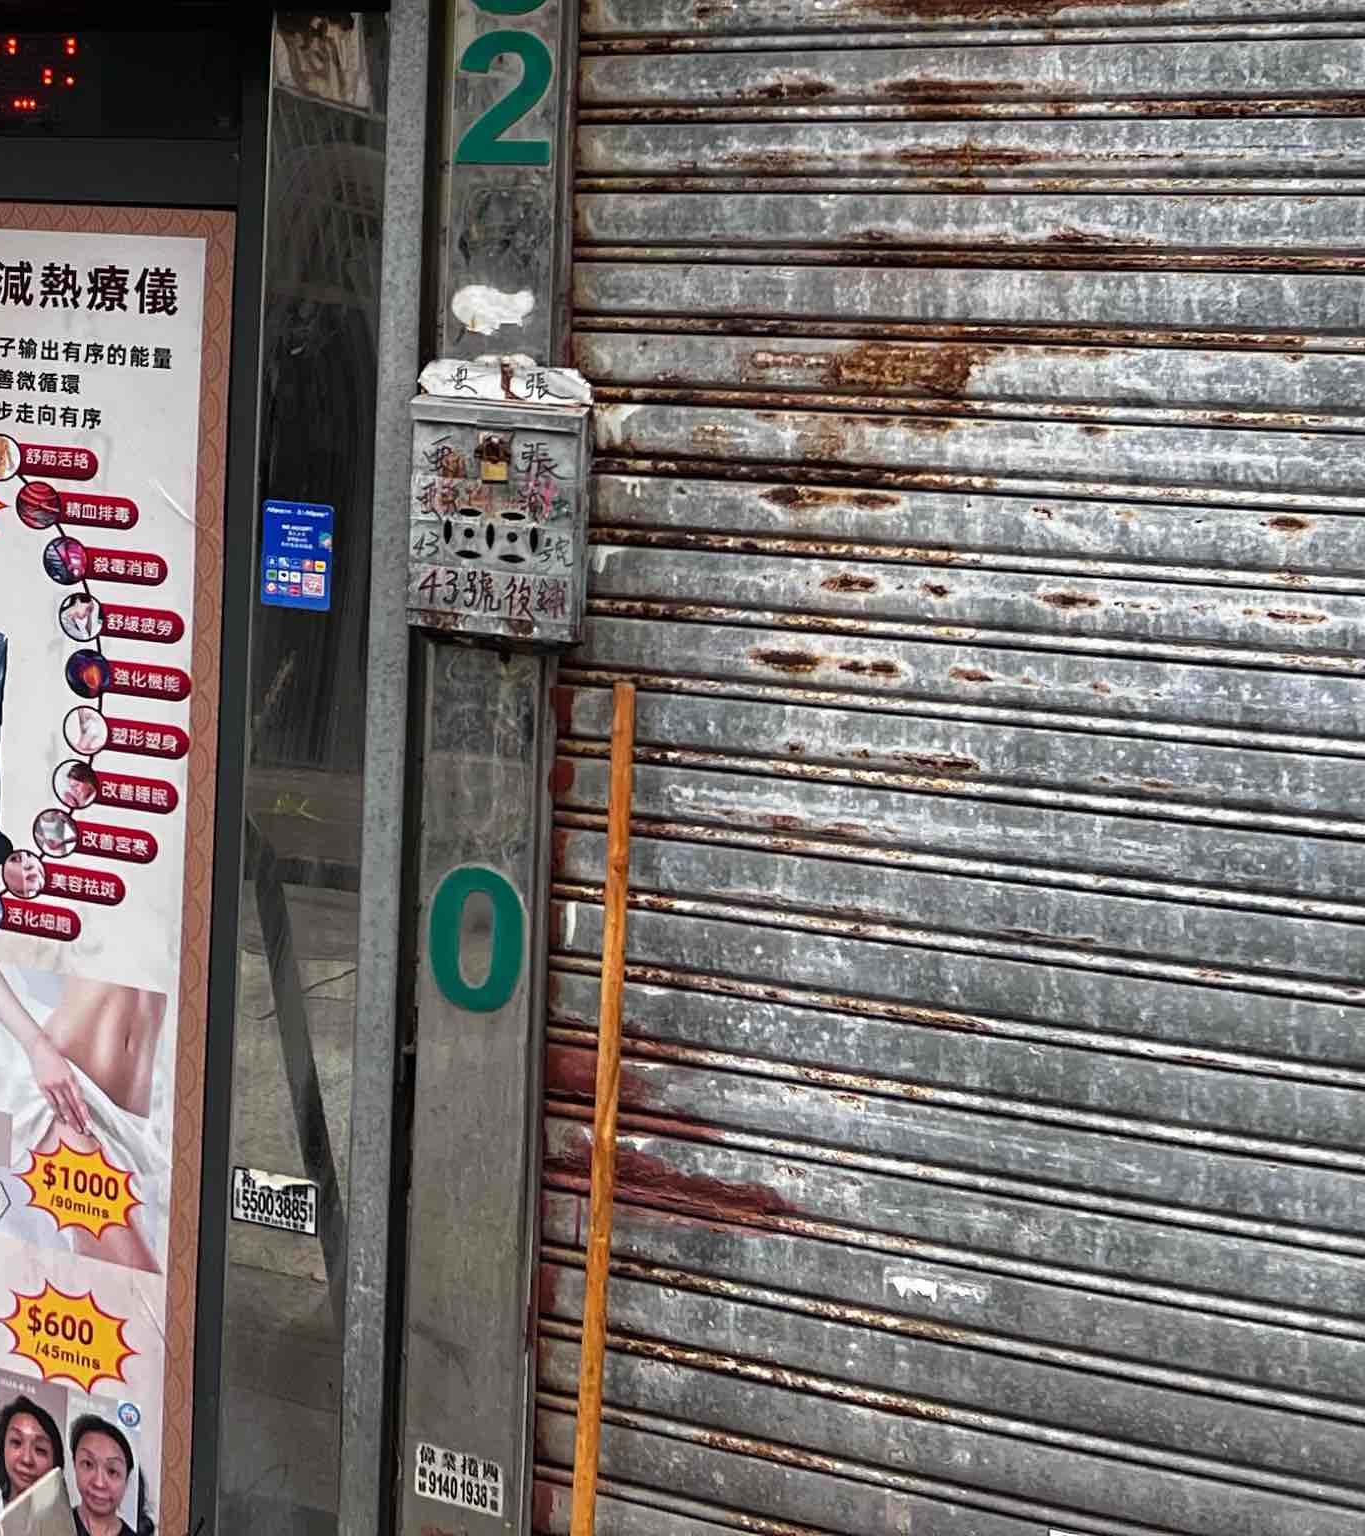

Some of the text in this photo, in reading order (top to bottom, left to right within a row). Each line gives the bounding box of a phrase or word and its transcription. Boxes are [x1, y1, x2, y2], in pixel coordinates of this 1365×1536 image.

[40, 1161, 121, 1203] $1000
[49, 1190, 111, 1221] /90mins
[25, 1303, 96, 1347] $600
[34, 1339, 103, 1372] /45mins
